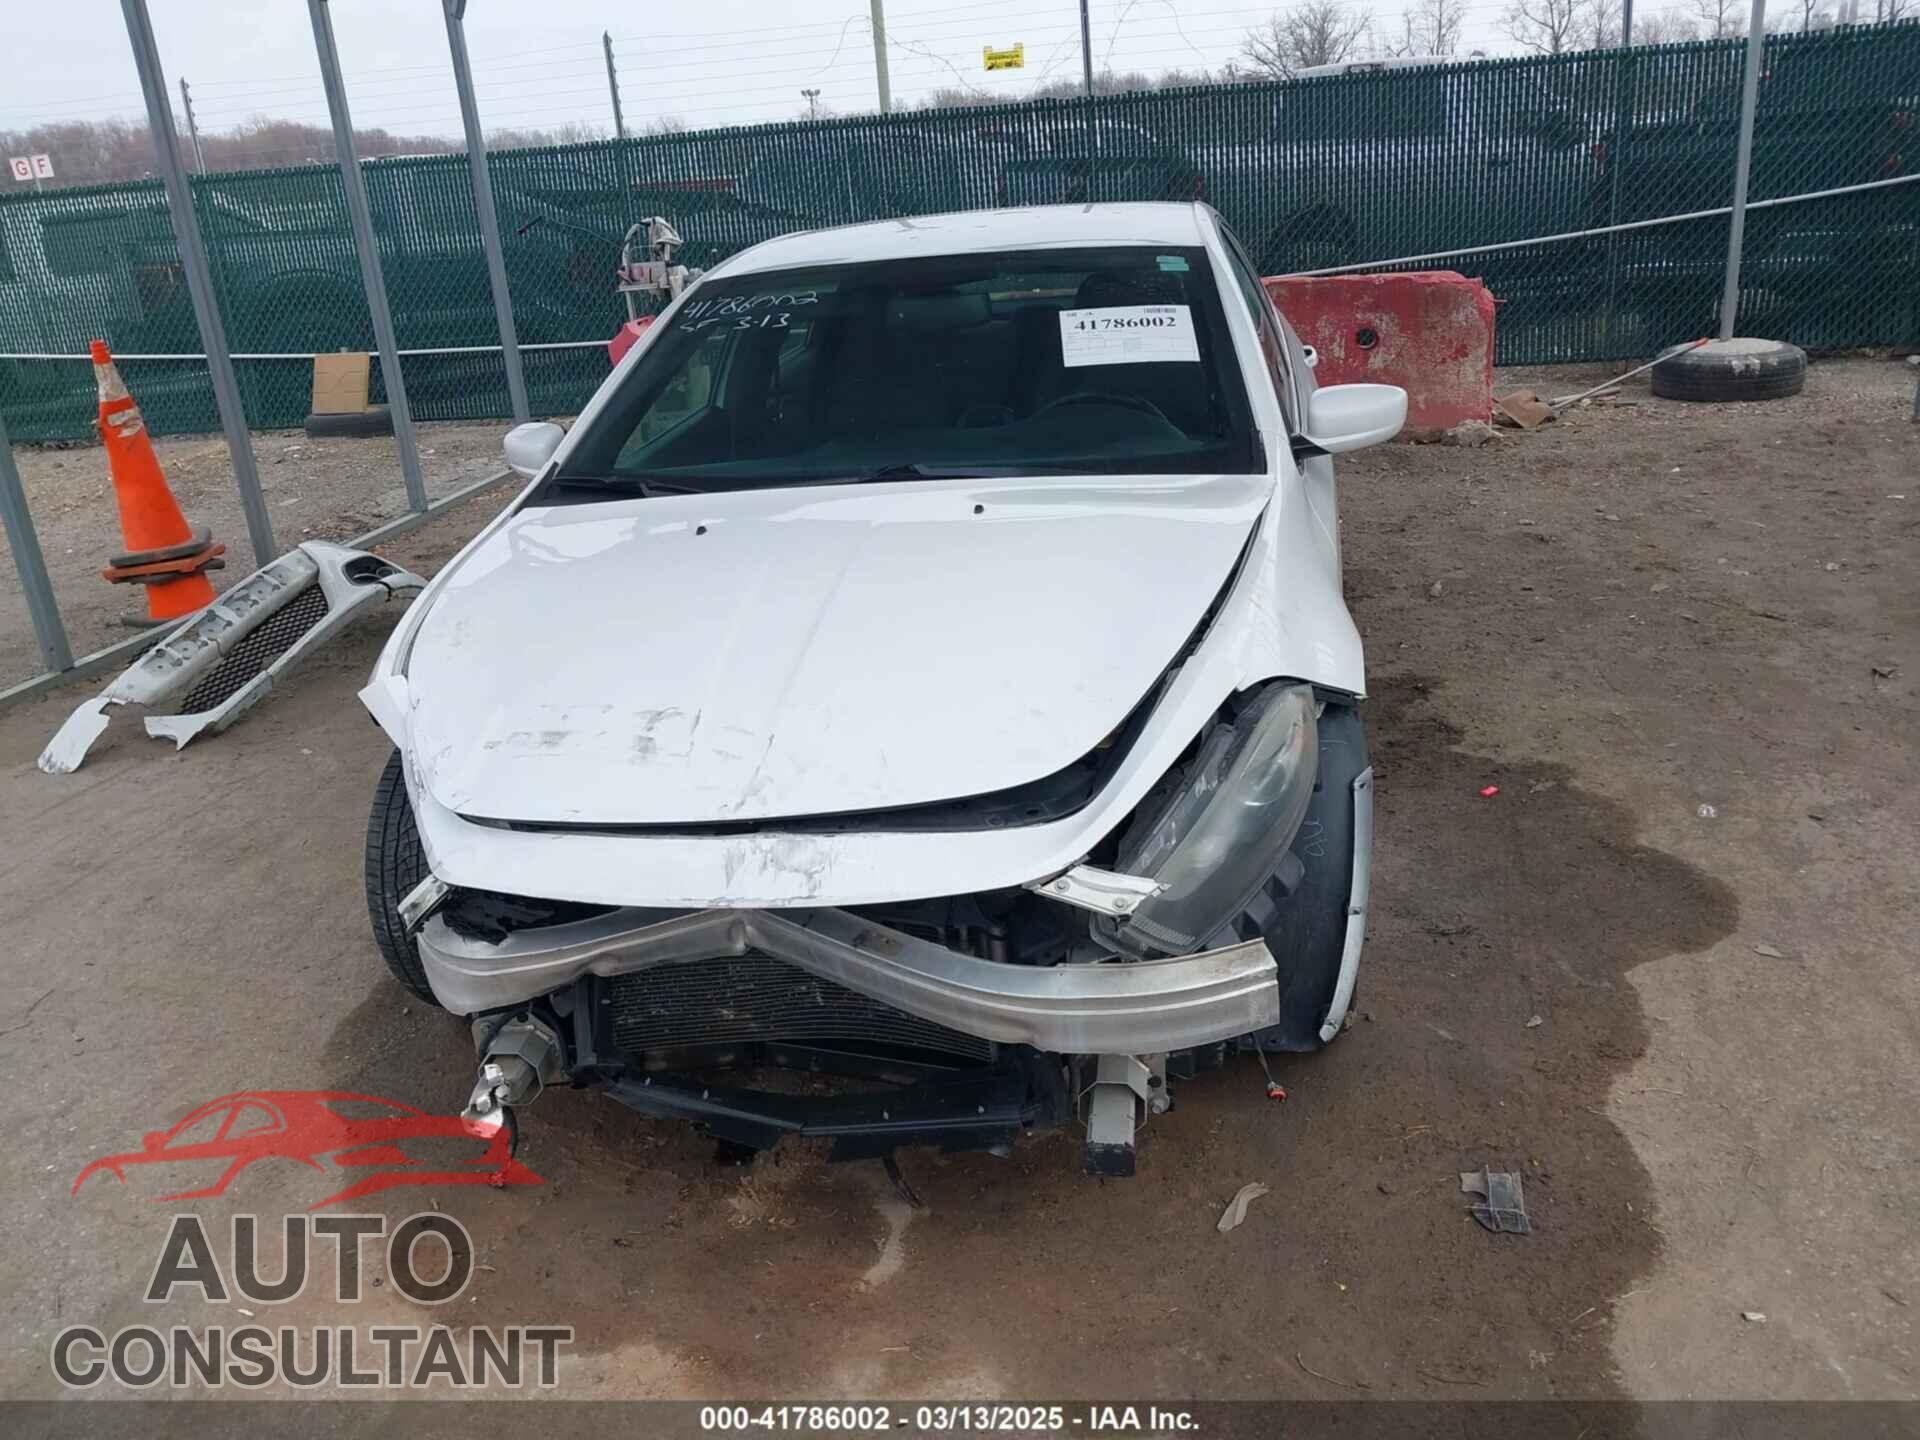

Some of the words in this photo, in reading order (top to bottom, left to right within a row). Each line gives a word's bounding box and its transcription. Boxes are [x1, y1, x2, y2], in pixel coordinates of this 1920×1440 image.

[15, 160, 28, 176] G
[37, 158, 46, 175] F
[1074, 317, 1177, 331] 41786002
